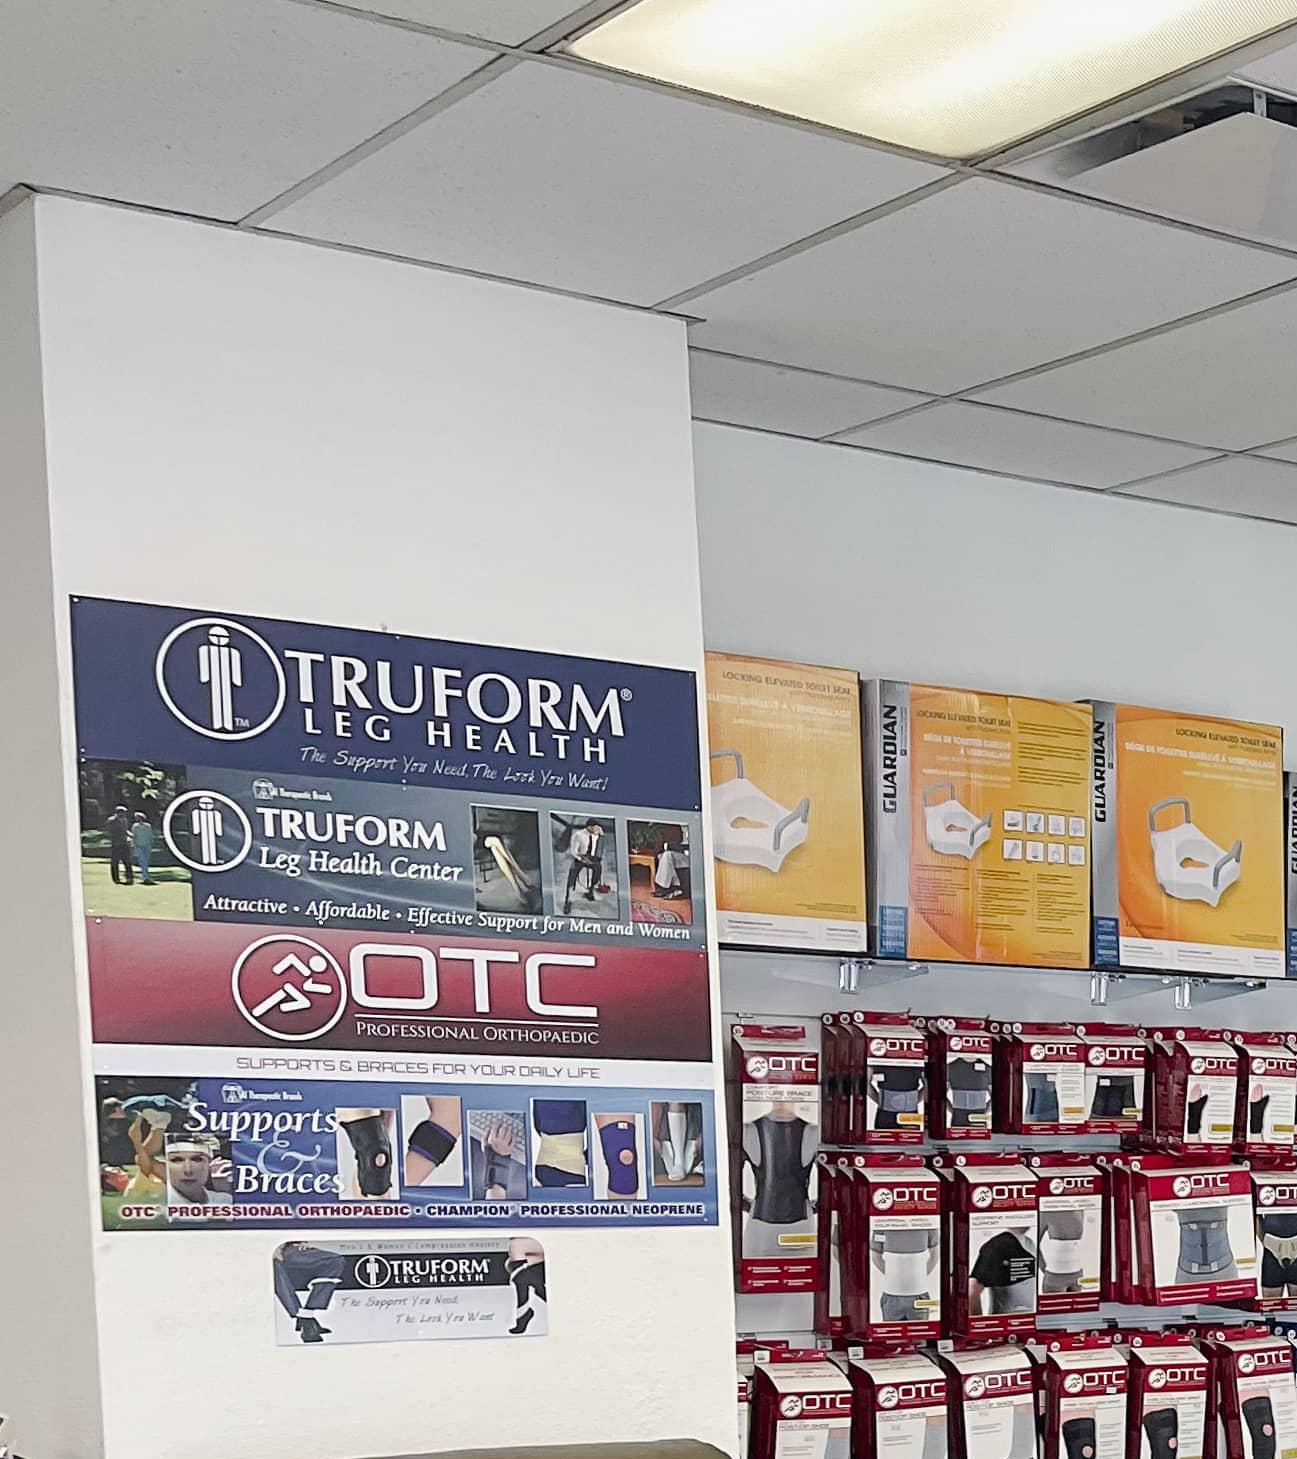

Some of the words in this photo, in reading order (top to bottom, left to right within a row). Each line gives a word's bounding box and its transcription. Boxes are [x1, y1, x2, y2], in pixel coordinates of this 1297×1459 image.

[304, 708, 391, 742] LEG
[427, 721, 607, 764] HEALTH
[300, 746, 327, 764] The
[333, 750, 398, 772] Support
[402, 755, 428, 774] You
[472, 763, 498, 780] The
[503, 769, 536, 784] Look
[539, 769, 563, 788] You
[882, 704, 898, 814] GUARDIAN
[1093, 720, 1106, 823] GUARDIAN
[256, 806, 447, 851] TRUFORM
[259, 846, 302, 877] Leg
[308, 850, 382, 876] Health
[390, 857, 464, 881] Center
[203, 894, 288, 914] Attractive
[305, 901, 391, 922] Affordable
[407, 907, 474, 927] Effective
[477, 912, 538, 932] Support
[540, 914, 565, 934] for
[569, 919, 602, 934] Men
[606, 921, 634, 936] and
[638, 924, 691, 940] Women
[349, 942, 599, 1018] OTC
[356, 1020, 480, 1040] PROFESSIONAL
[482, 1026, 600, 1045] ORTHOPAEDIC
[886, 1038, 923, 1051] OTC
[961, 1037, 990, 1048] OTC
[1045, 1042, 1078, 1056] OTC
[1105, 1046, 1146, 1061] OTC
[236, 1056, 336, 1071] SUPPORTS
[339, 1059, 352, 1072] &
[357, 1060, 429, 1074] BRACES
[432, 1063, 467, 1075] FOR
[469, 1063, 516, 1077] YOUR
[518, 1065, 564, 1078] DAILY
[567, 1067, 601, 1079] LIFE
[768, 1056, 817, 1072] OTC
[1206, 1057, 1237, 1071] OTC
[1263, 1058, 1296, 1072] OTC
[184, 1101, 340, 1142] Supports
[256, 1128, 321, 1175] &
[235, 1164, 346, 1194] Braces
[1063, 1177, 1094, 1188] OTC
[1191, 1172, 1229, 1189] OTC
[893, 1187, 937, 1202] OTC
[992, 1185, 1036, 1200] OTC
[168, 1205, 293, 1217] PROFESSIONAL
[298, 1205, 409, 1217] ORTHOPAEDIC
[427, 1204, 510, 1216] CHAMPION
[521, 1204, 628, 1216] PROFESSIONAL
[632, 1204, 703, 1215] NEOPRENE
[394, 1275, 421, 1284] LEG
[429, 1273, 484, 1283] HEALTH
[1254, 1349, 1291, 1366] OTC
[985, 1370, 1032, 1388] OTC
[1082, 1368, 1126, 1386] OTC
[1166, 1366, 1206, 1383] OTC
[898, 1382, 945, 1400] OTC
[802, 1394, 851, 1410] OTC
